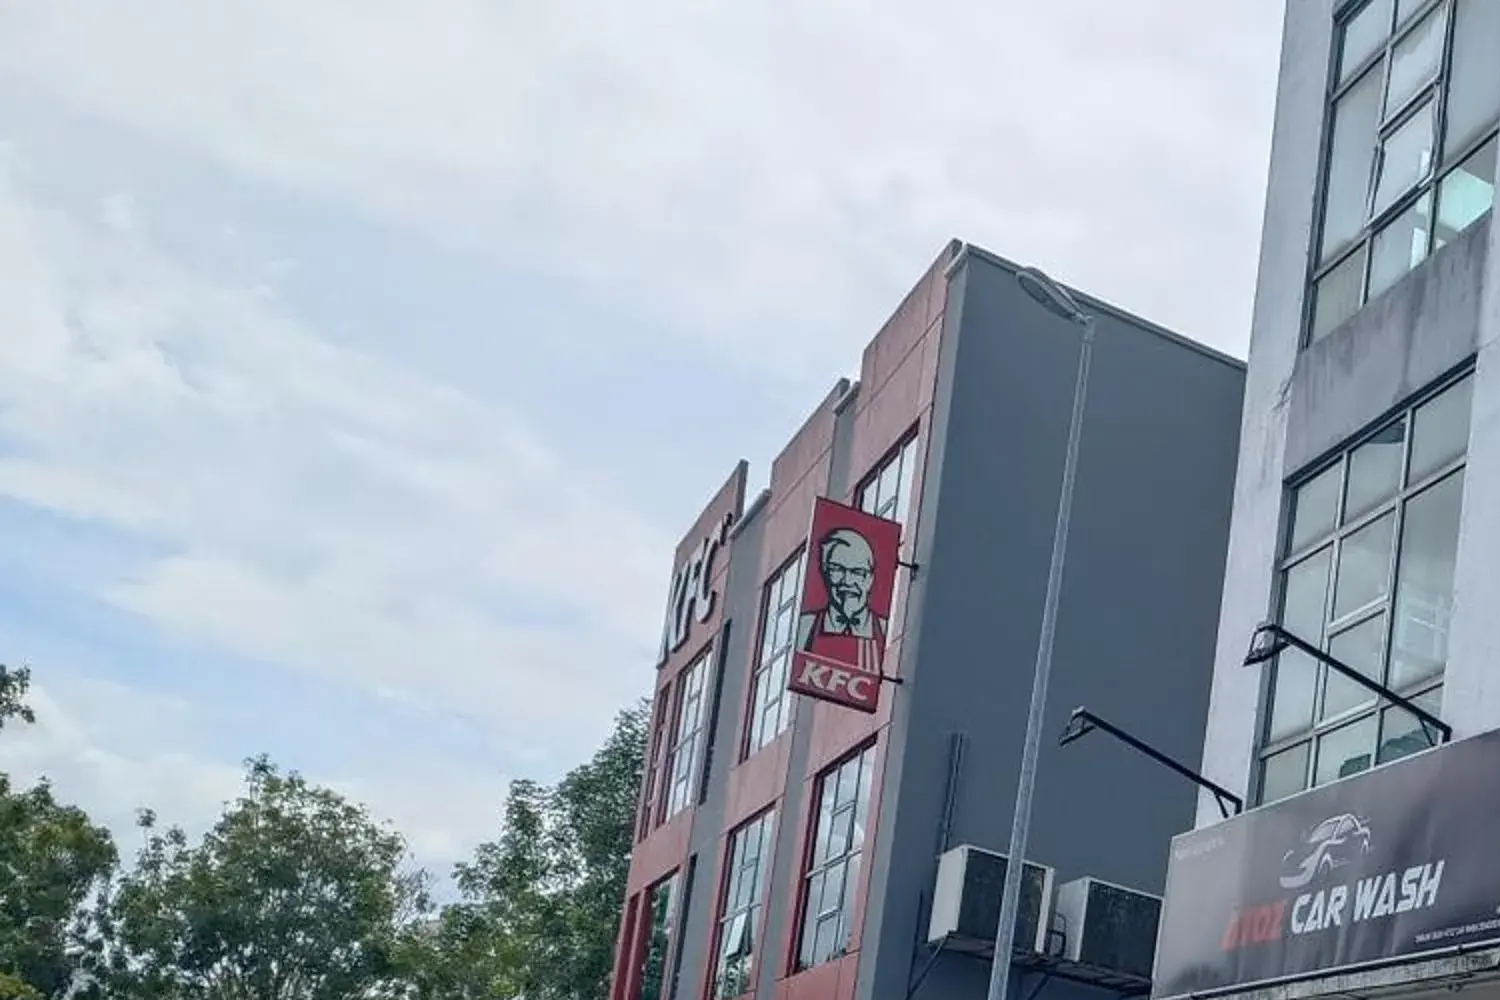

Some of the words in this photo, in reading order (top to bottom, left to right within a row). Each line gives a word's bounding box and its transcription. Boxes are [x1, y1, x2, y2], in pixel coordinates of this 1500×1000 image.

[799, 659, 872, 701] KFC
[1291, 884, 1348, 935] CAR
[1353, 859, 1446, 922] WASH
